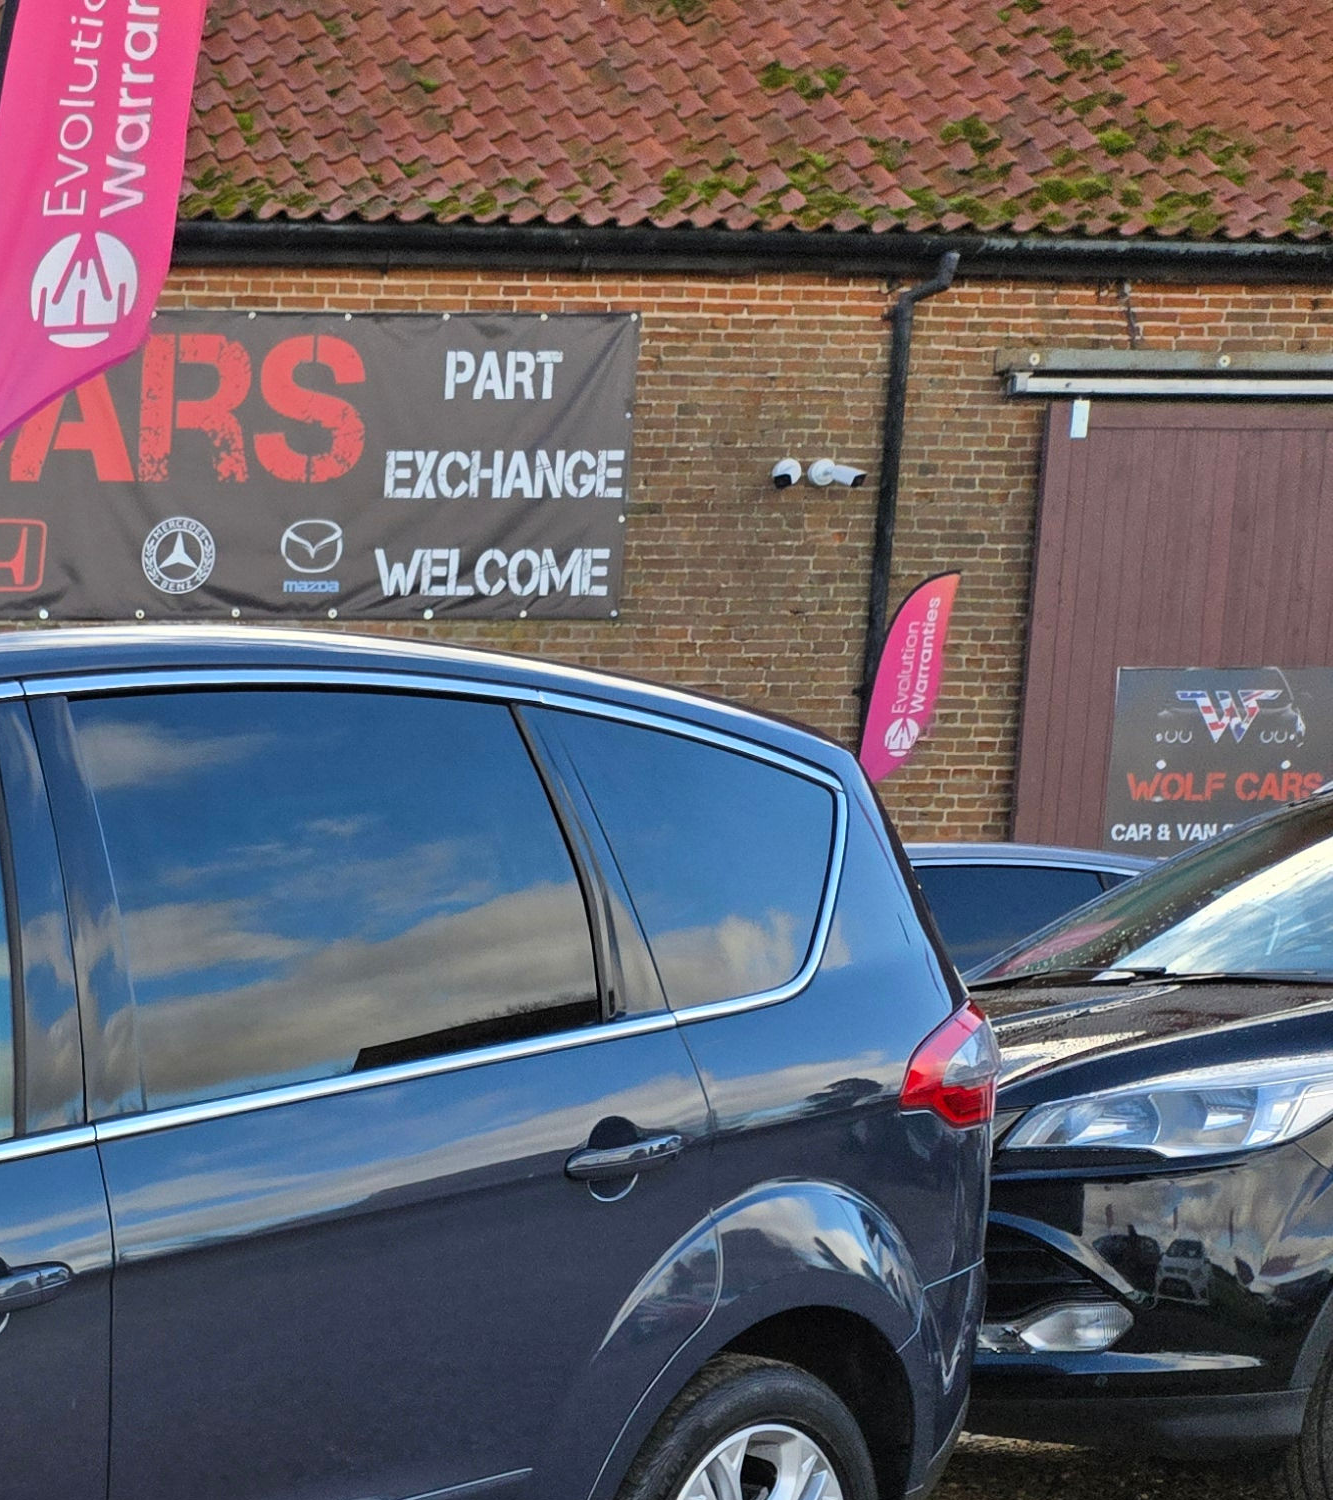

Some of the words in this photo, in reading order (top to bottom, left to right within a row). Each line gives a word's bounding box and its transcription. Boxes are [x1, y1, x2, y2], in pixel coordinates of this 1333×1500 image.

[43, 0, 106, 216] Evoluti
[100, 0, 160, 218] Warra
[444, 350, 564, 400] PART
[383, 448, 625, 500] EXCHANGE
[152, 519, 207, 541] MERCEDES
[160, 579, 194, 592] BENZ
[375, 547, 611, 598] WELCOME
[892, 621, 920, 713] Evolution
[909, 597, 941, 714] Warranties
[1127, 771, 1227, 801] WOLF
[1235, 771, 1323, 801] CARS
[1111, 823, 1152, 841] CAR
[1157, 824, 1170, 841] &
[1177, 823, 1218, 841] VAN
